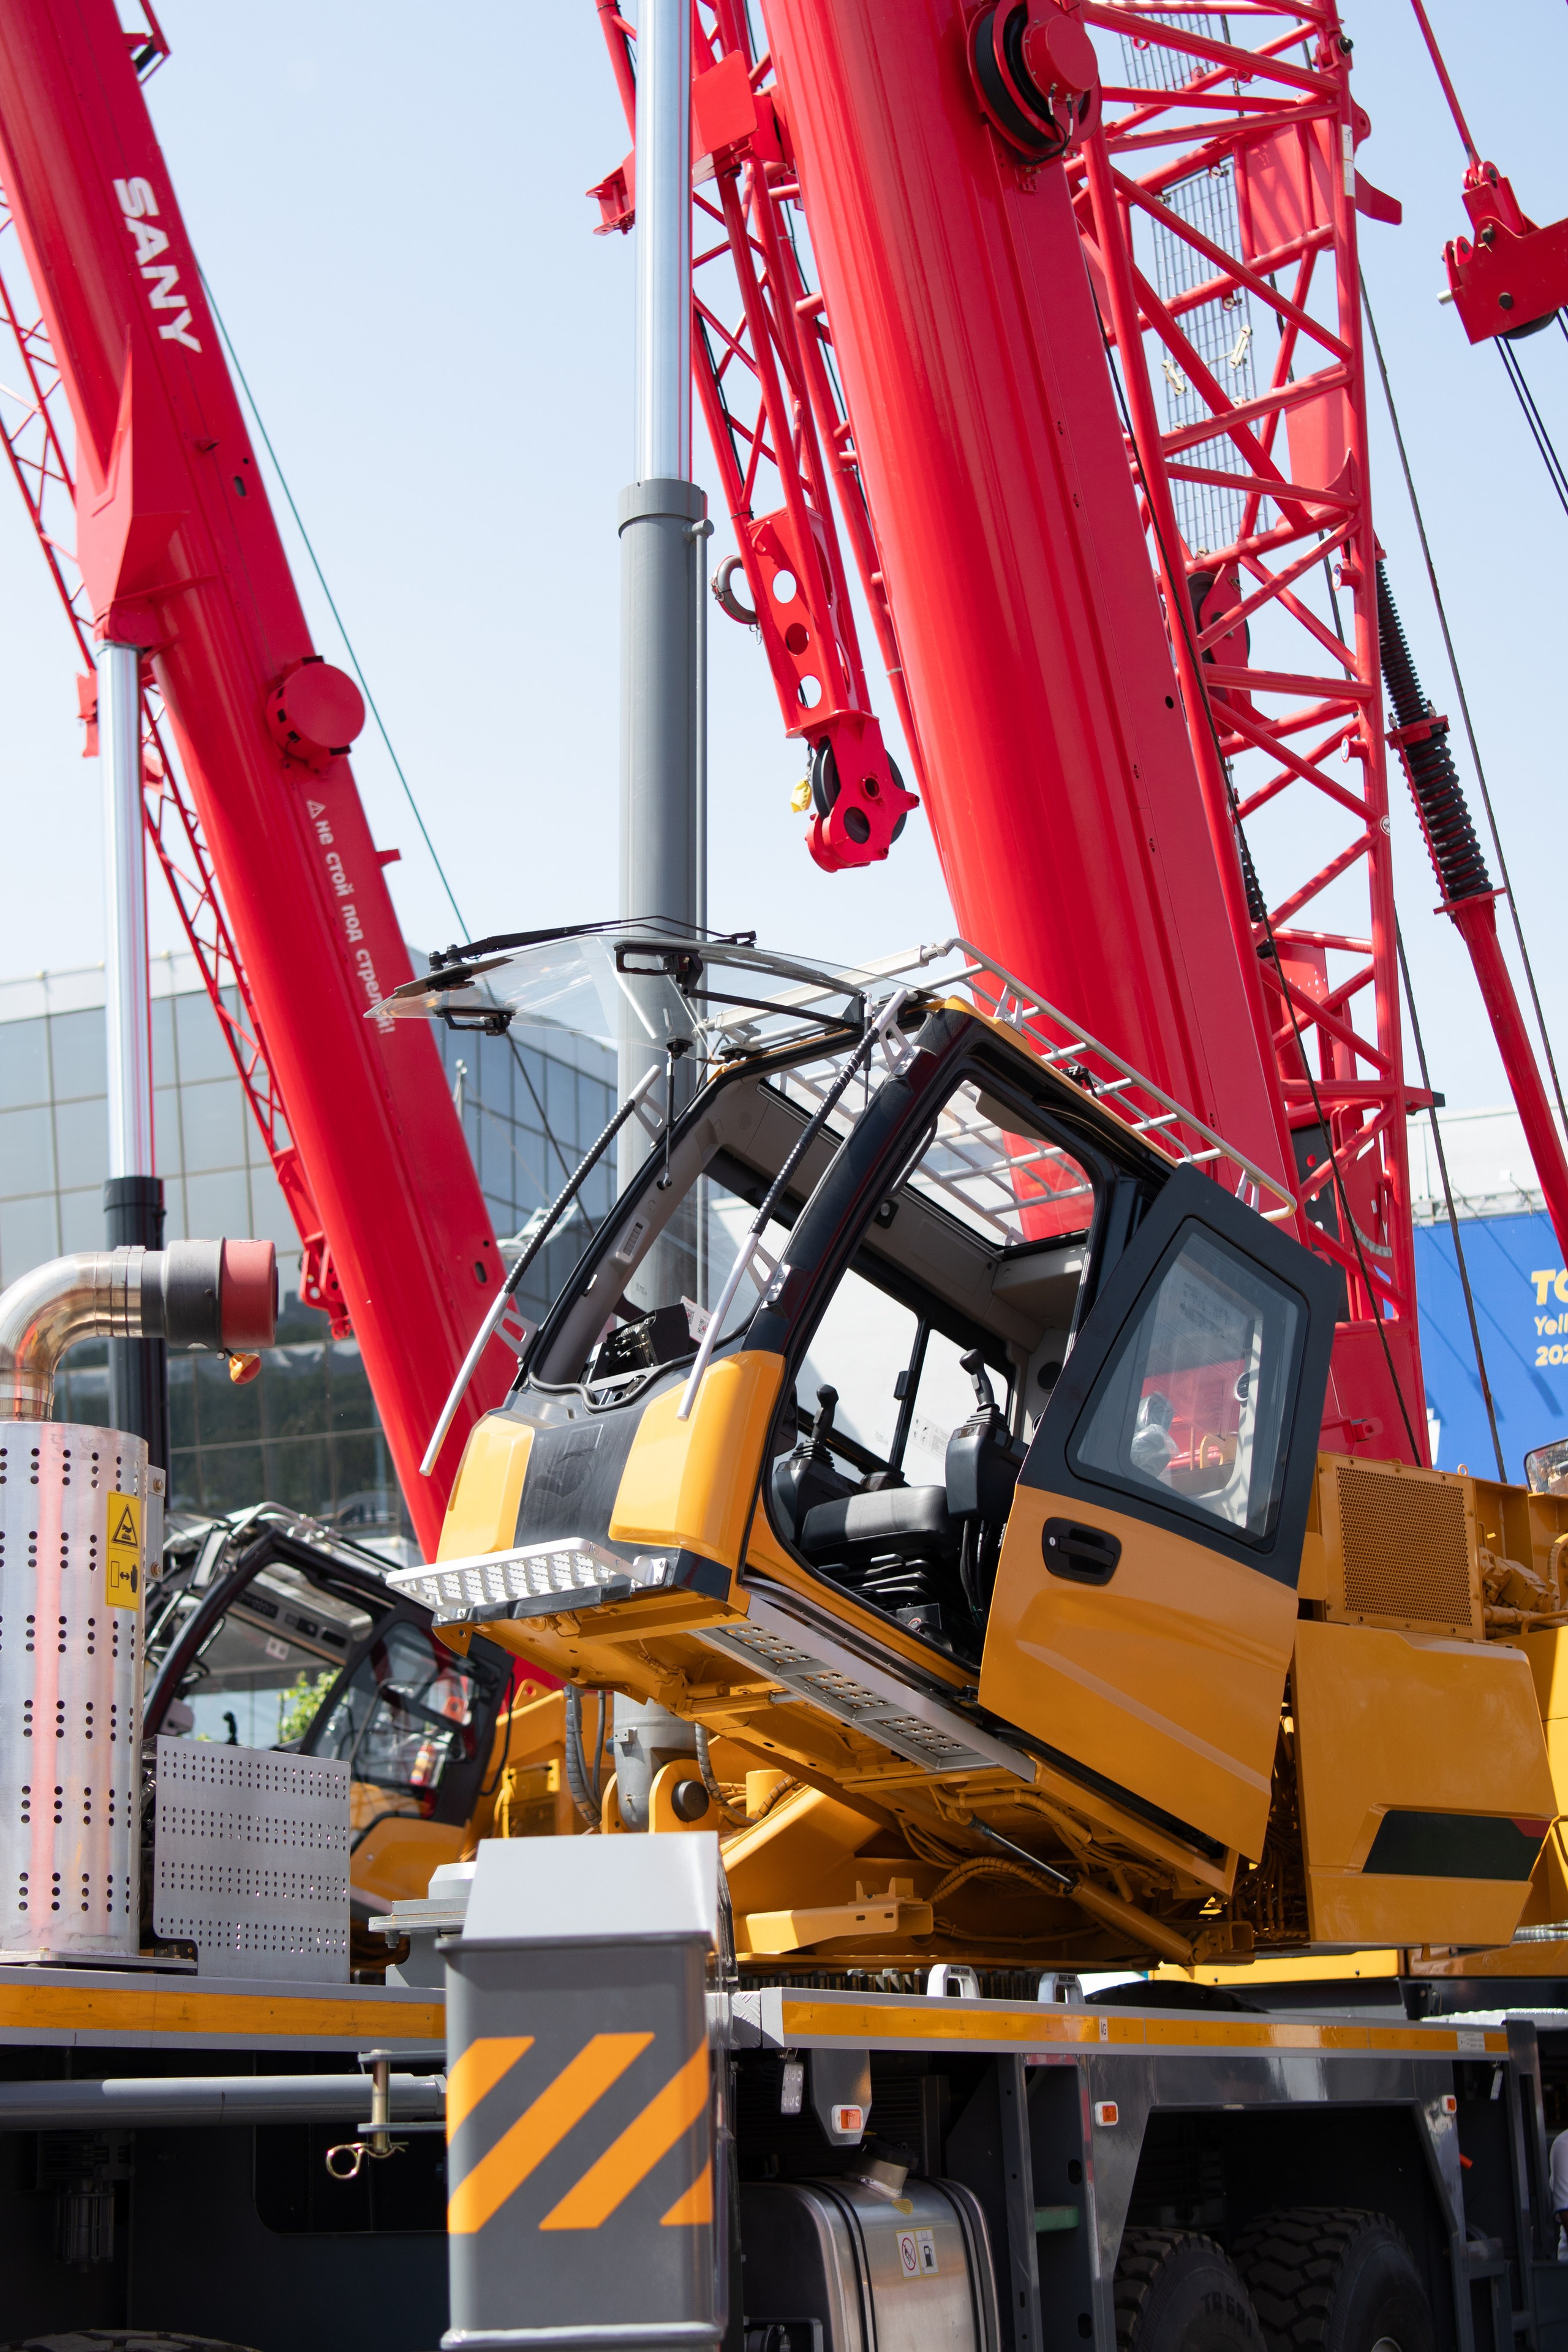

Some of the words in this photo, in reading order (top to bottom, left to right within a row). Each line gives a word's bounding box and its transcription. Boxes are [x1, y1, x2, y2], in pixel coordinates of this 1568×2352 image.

[113, 177, 203, 353] SANY
[315, 820, 334, 845] не
[326, 852, 355, 897] стой
[341, 905, 364, 943] под
[356, 948, 396, 1034] стрелй!
